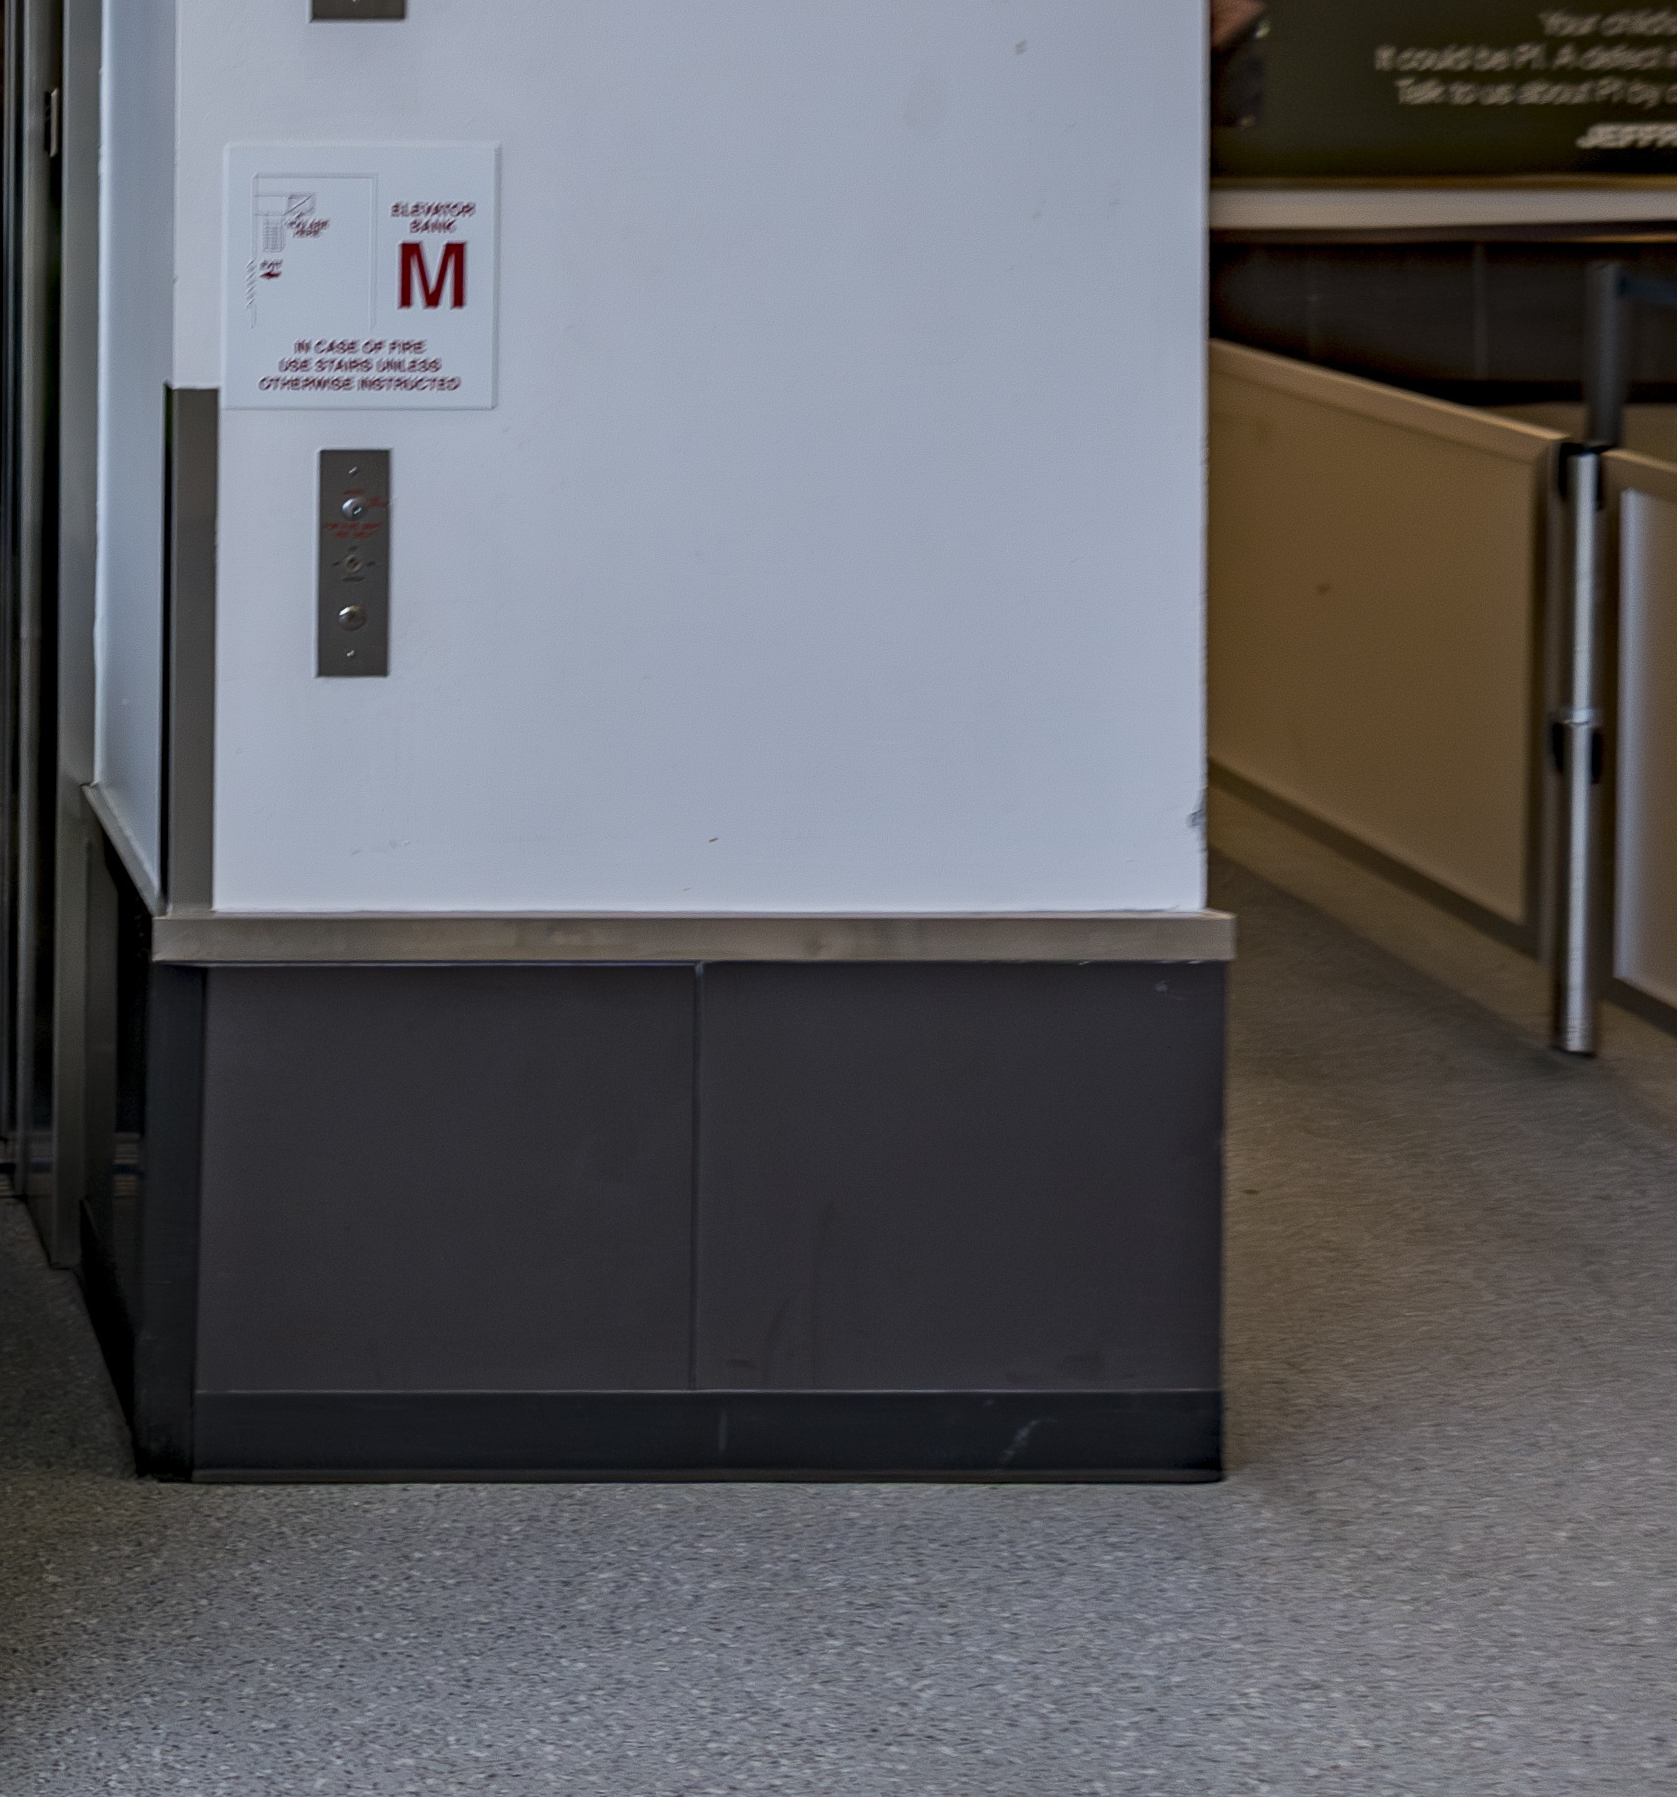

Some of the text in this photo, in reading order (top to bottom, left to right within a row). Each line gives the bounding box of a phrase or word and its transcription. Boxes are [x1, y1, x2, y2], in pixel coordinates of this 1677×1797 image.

[390, 201, 476, 218] ELEVATOR
[409, 219, 457, 234] BANK
[397, 240, 468, 310] M
[294, 339, 427, 354] IN CASE OF FIRE
[279, 358, 442, 373] USE STAIRS UNLESS
[258, 376, 462, 391] OTHERWISE INSTRUCTED
